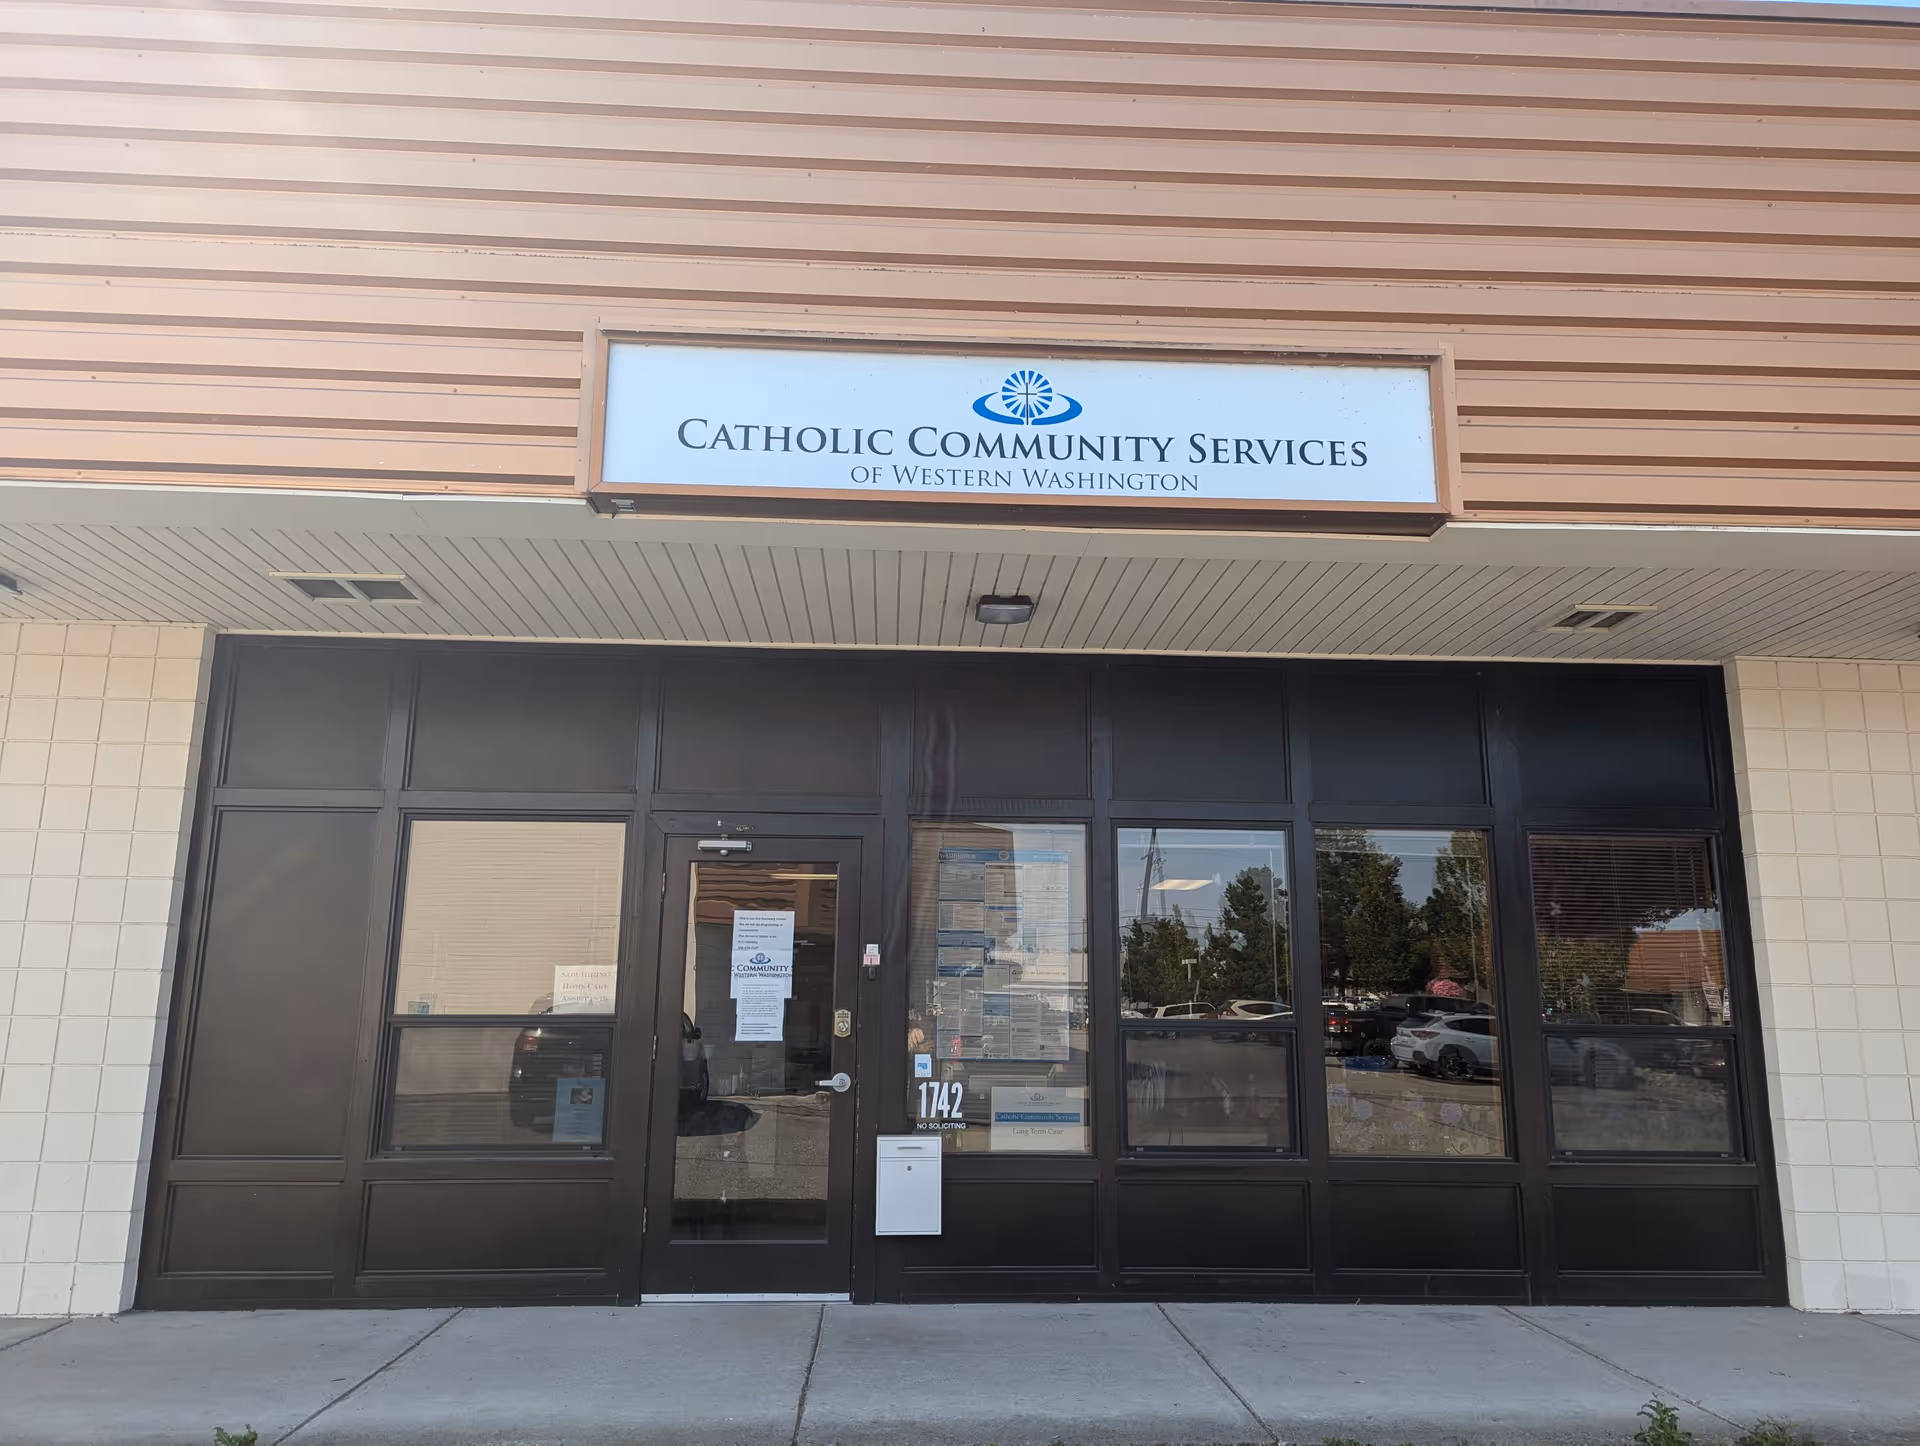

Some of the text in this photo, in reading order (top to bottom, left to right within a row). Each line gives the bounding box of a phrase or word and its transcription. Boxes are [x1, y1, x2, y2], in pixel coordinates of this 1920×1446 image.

[677, 417, 1369, 467] CATHOLIC COMMUNITY SERVICES
[850, 464, 1199, 492] OF WESTERN WASHINGTON
[736, 964, 789, 972] COMMUNITY
[918, 1081, 963, 1119] 1742
[916, 1122, 967, 1130] NO SOLICITING
[1012, 1127, 1029, 1136] Long
